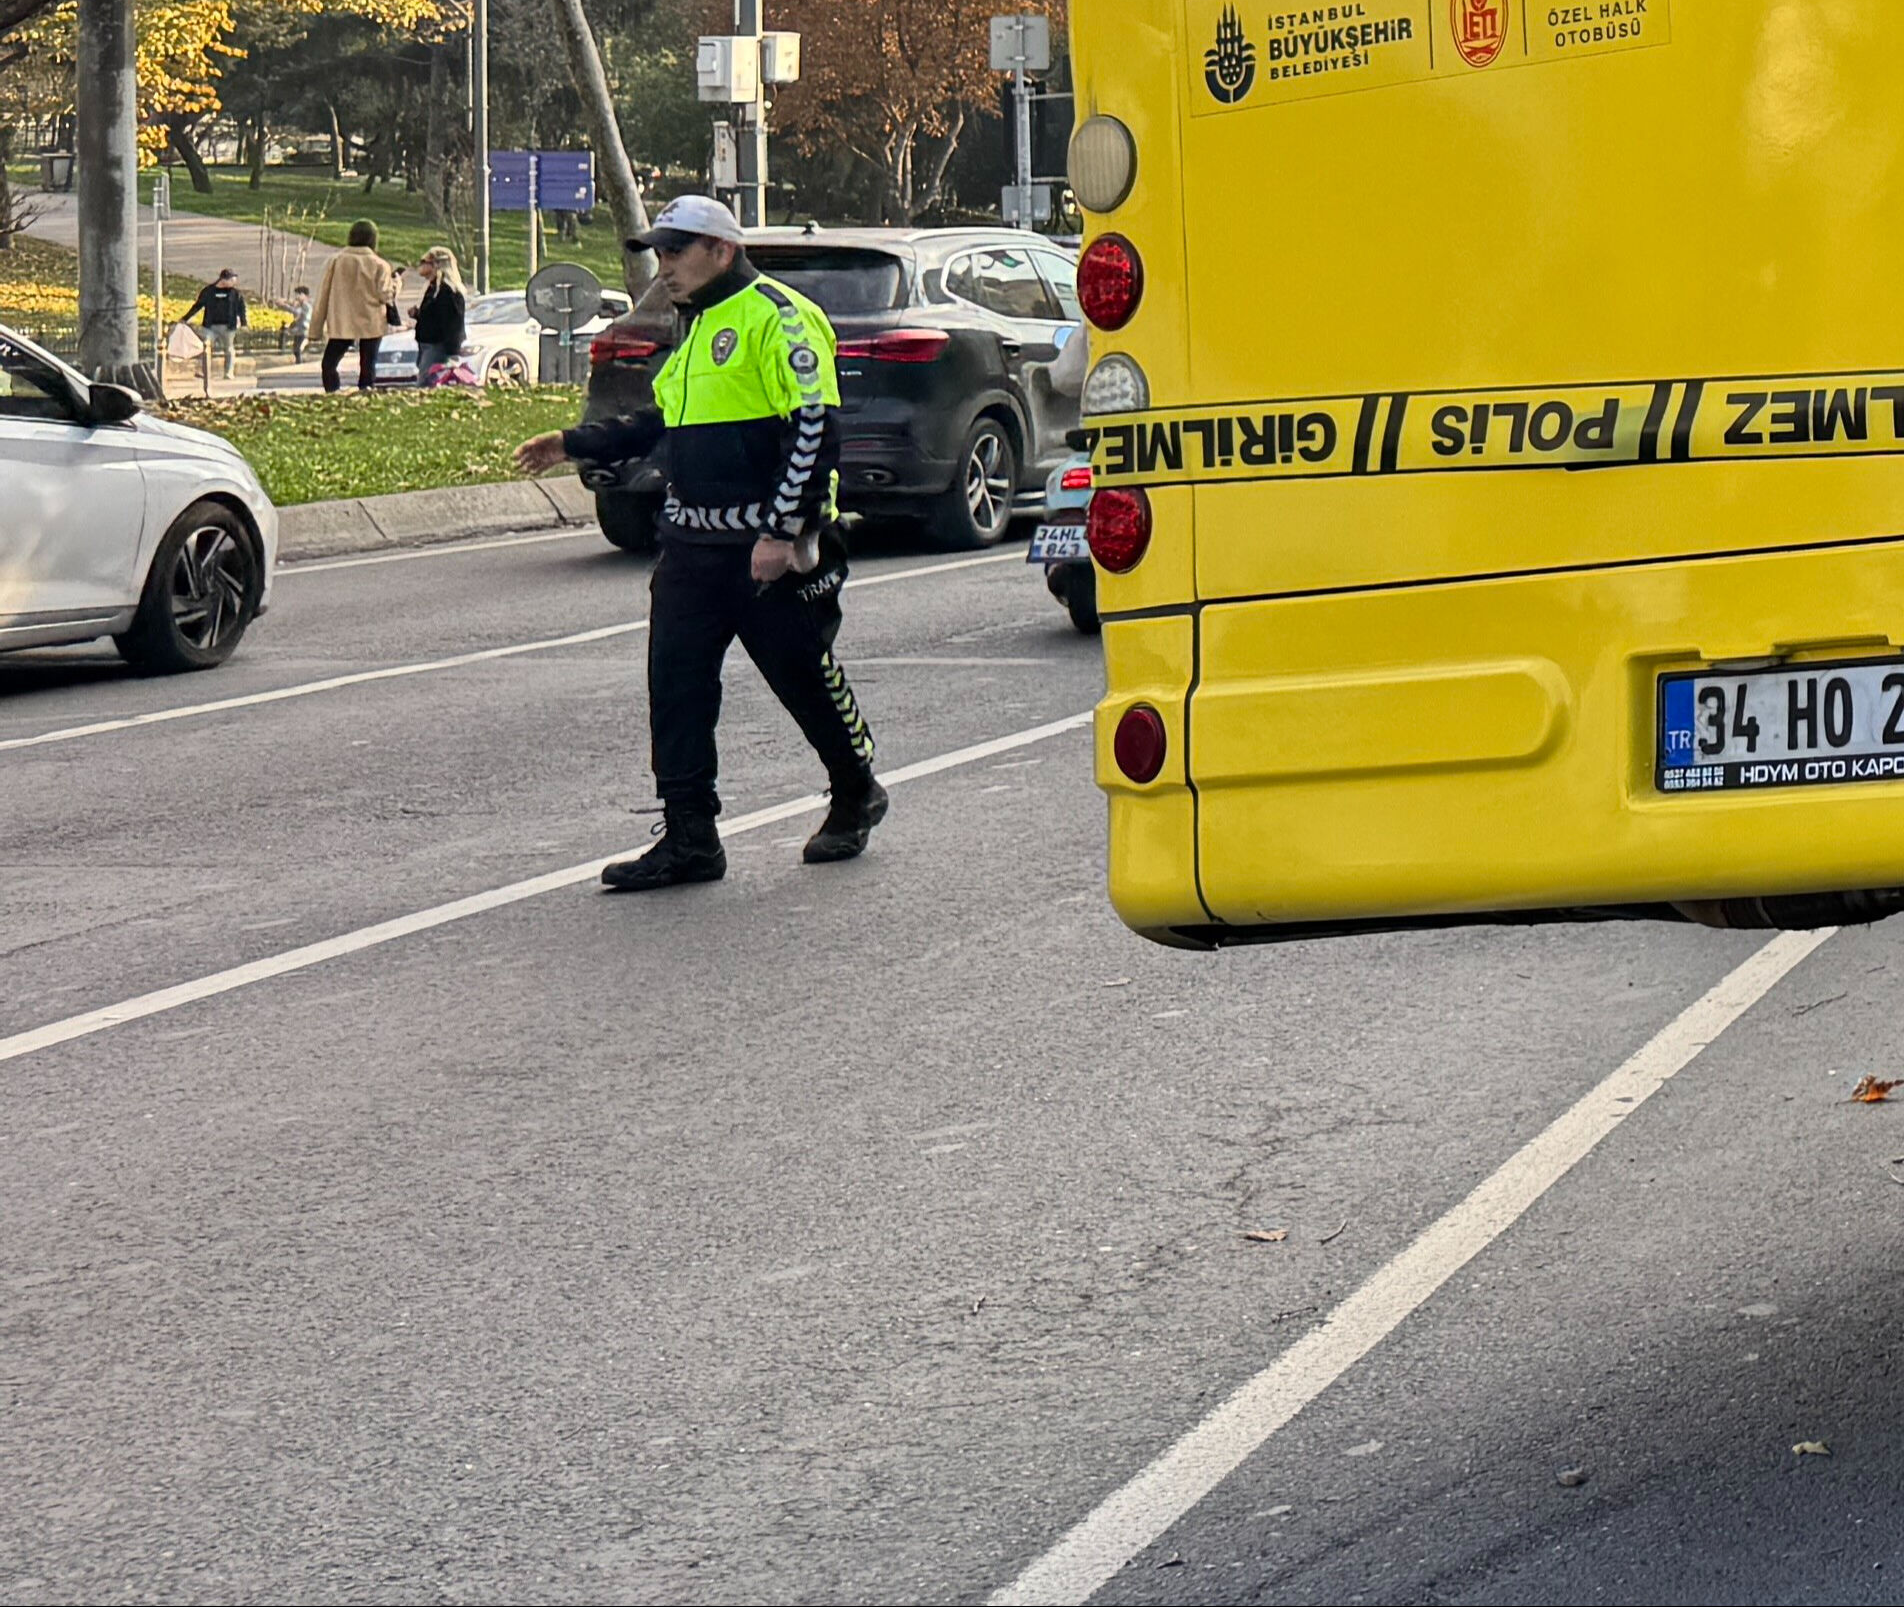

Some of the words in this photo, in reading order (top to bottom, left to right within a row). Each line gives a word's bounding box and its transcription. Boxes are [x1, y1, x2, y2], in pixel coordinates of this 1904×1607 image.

[1268, 3, 1366, 31] İSTANBUL
[1548, 6, 1593, 27] ÖZEL
[1269, 17, 1413, 61] BÜYÜKŞEHİR
[1555, 17, 1641, 48] OTOBÜSÜ
[1270, 49, 1369, 80] BELEDİYESİ
[1668, 730, 1691, 750] TR
[1697, 683, 1760, 755] 34
[1786, 676, 1854, 750] HO
[1805, 760, 1846, 780] OTO
